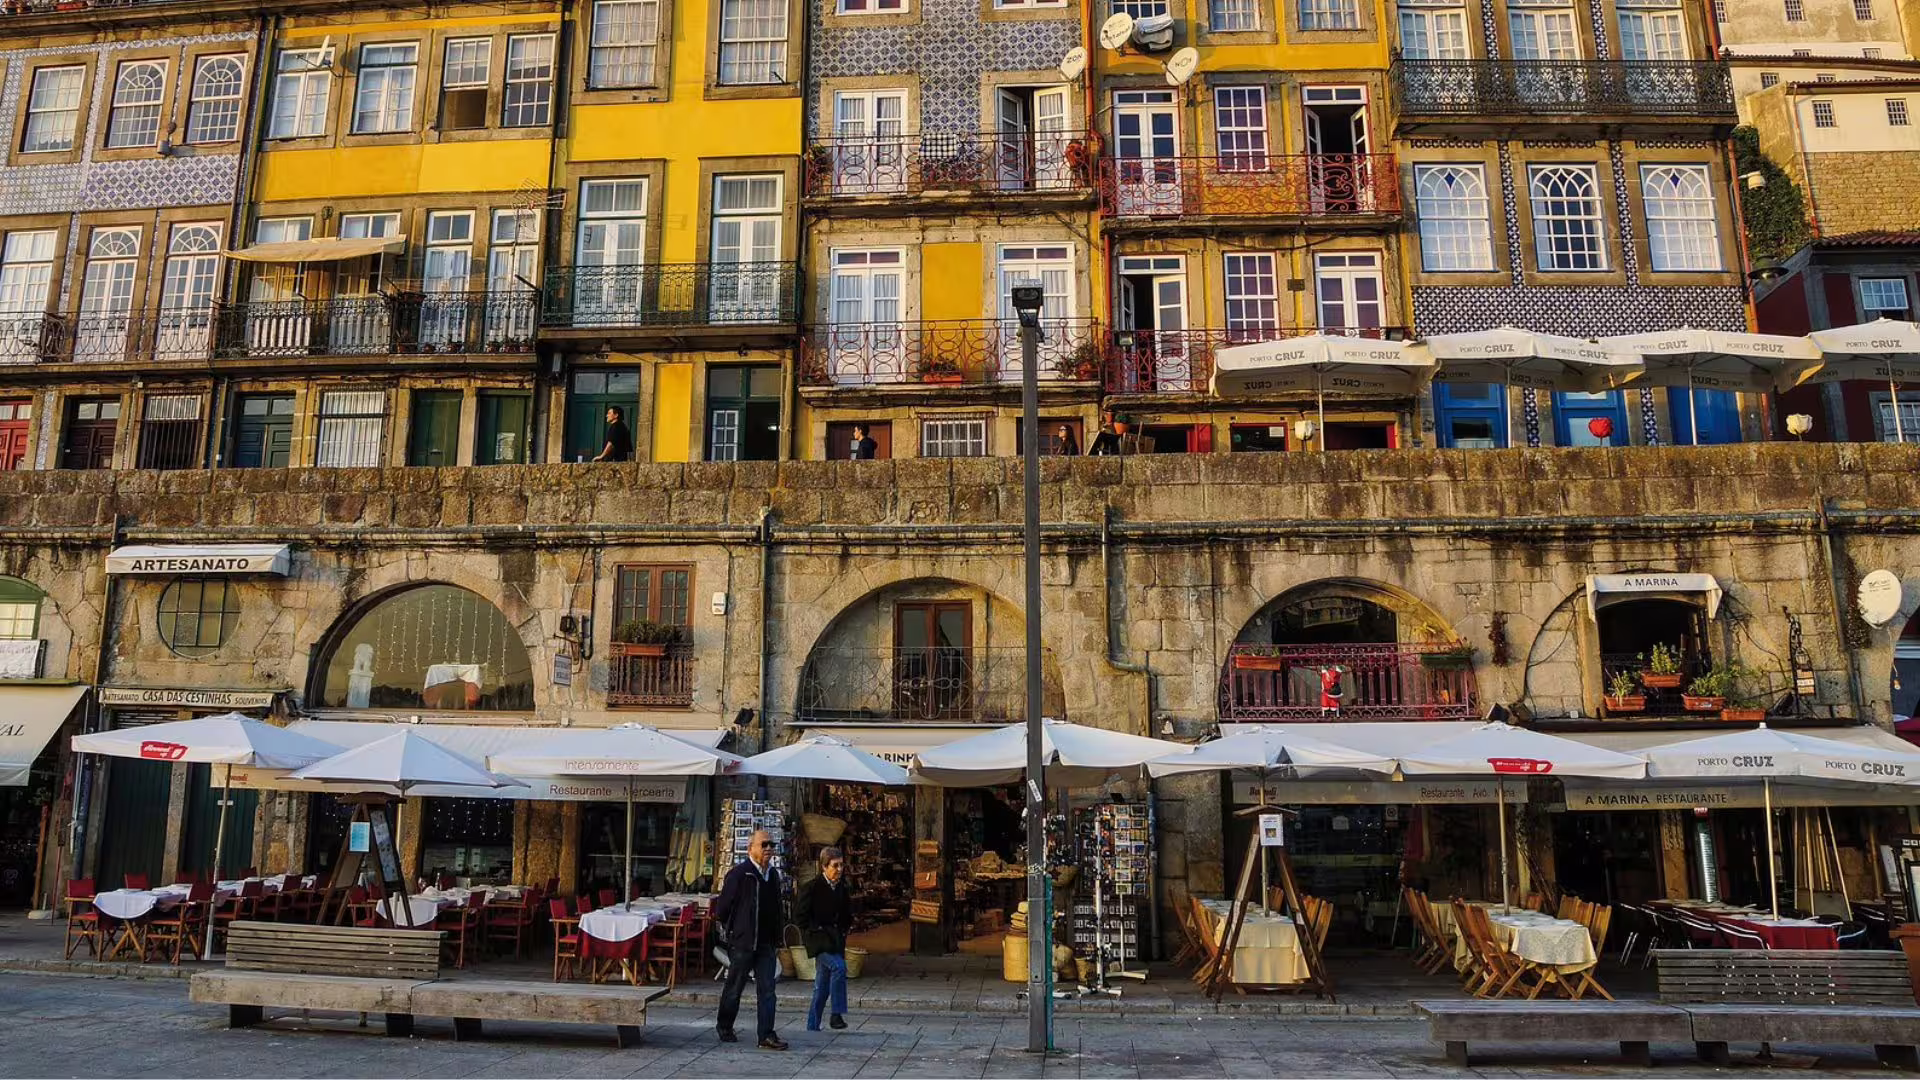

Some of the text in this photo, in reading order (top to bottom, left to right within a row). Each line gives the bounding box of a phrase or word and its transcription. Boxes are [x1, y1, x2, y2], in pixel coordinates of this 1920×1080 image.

[1066, 53, 1083, 63] ZON
[1484, 344, 1514, 353] CRUZ
[1658, 340, 1688, 350] CRUZ
[1726, 342, 1785, 353] PORTO CRUZ
[1871, 339, 1902, 348] CRUZ
[1250, 350, 1305, 363] PORTO CRUZ
[1370, 351, 1400, 360] CRUZ
[1579, 349, 1609, 360] CRUZ
[131, 558, 249, 571] ARTESANATO
[1635, 578, 1679, 586] MARINA
[142, 691, 164, 702] CASA
[166, 691, 184, 702] DAS
[185, 692, 232, 705] CESTINHAS
[564, 759, 639, 771] Intensamente
[1698, 756, 1774, 767] PORTO CRUZ
[1825, 761, 1905, 777] PORTO CRUZ
[550, 785, 612, 796] Restaurante
[1421, 787, 1465, 798] Restaurante
[1585, 793, 1727, 805] A MARINA RESTAURANTE
